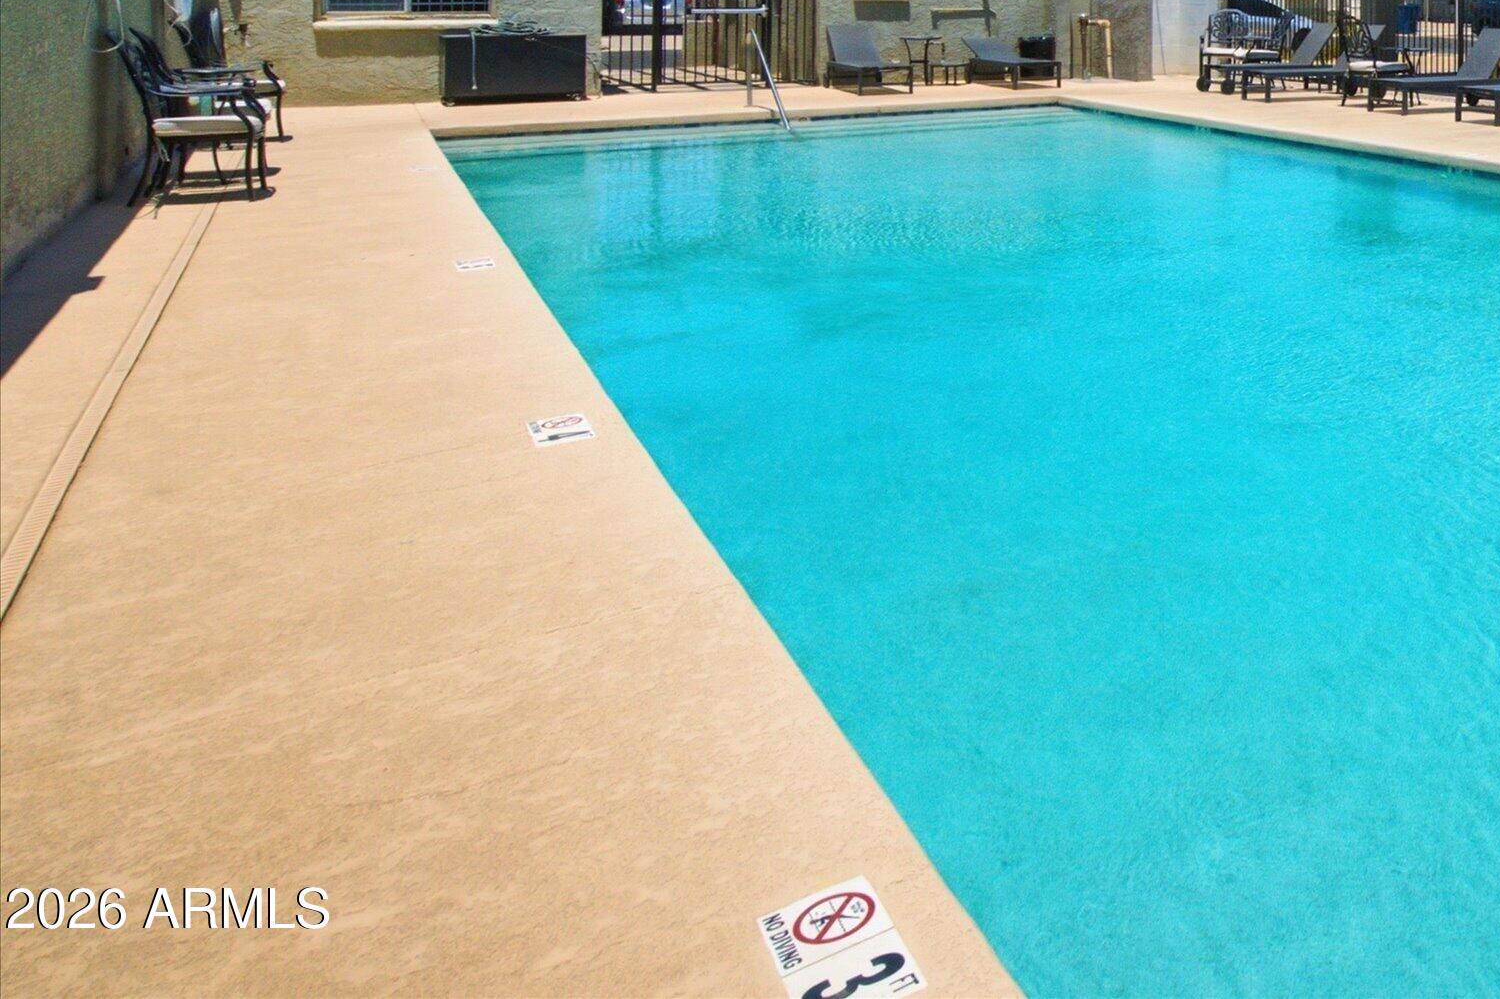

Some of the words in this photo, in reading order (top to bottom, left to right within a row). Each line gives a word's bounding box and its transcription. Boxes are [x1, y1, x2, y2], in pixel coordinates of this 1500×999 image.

[762, 912, 785, 931] NO
[770, 929, 803, 970] DIVING
[801, 952, 906, 999] 3
[889, 972, 919, 993] FT
